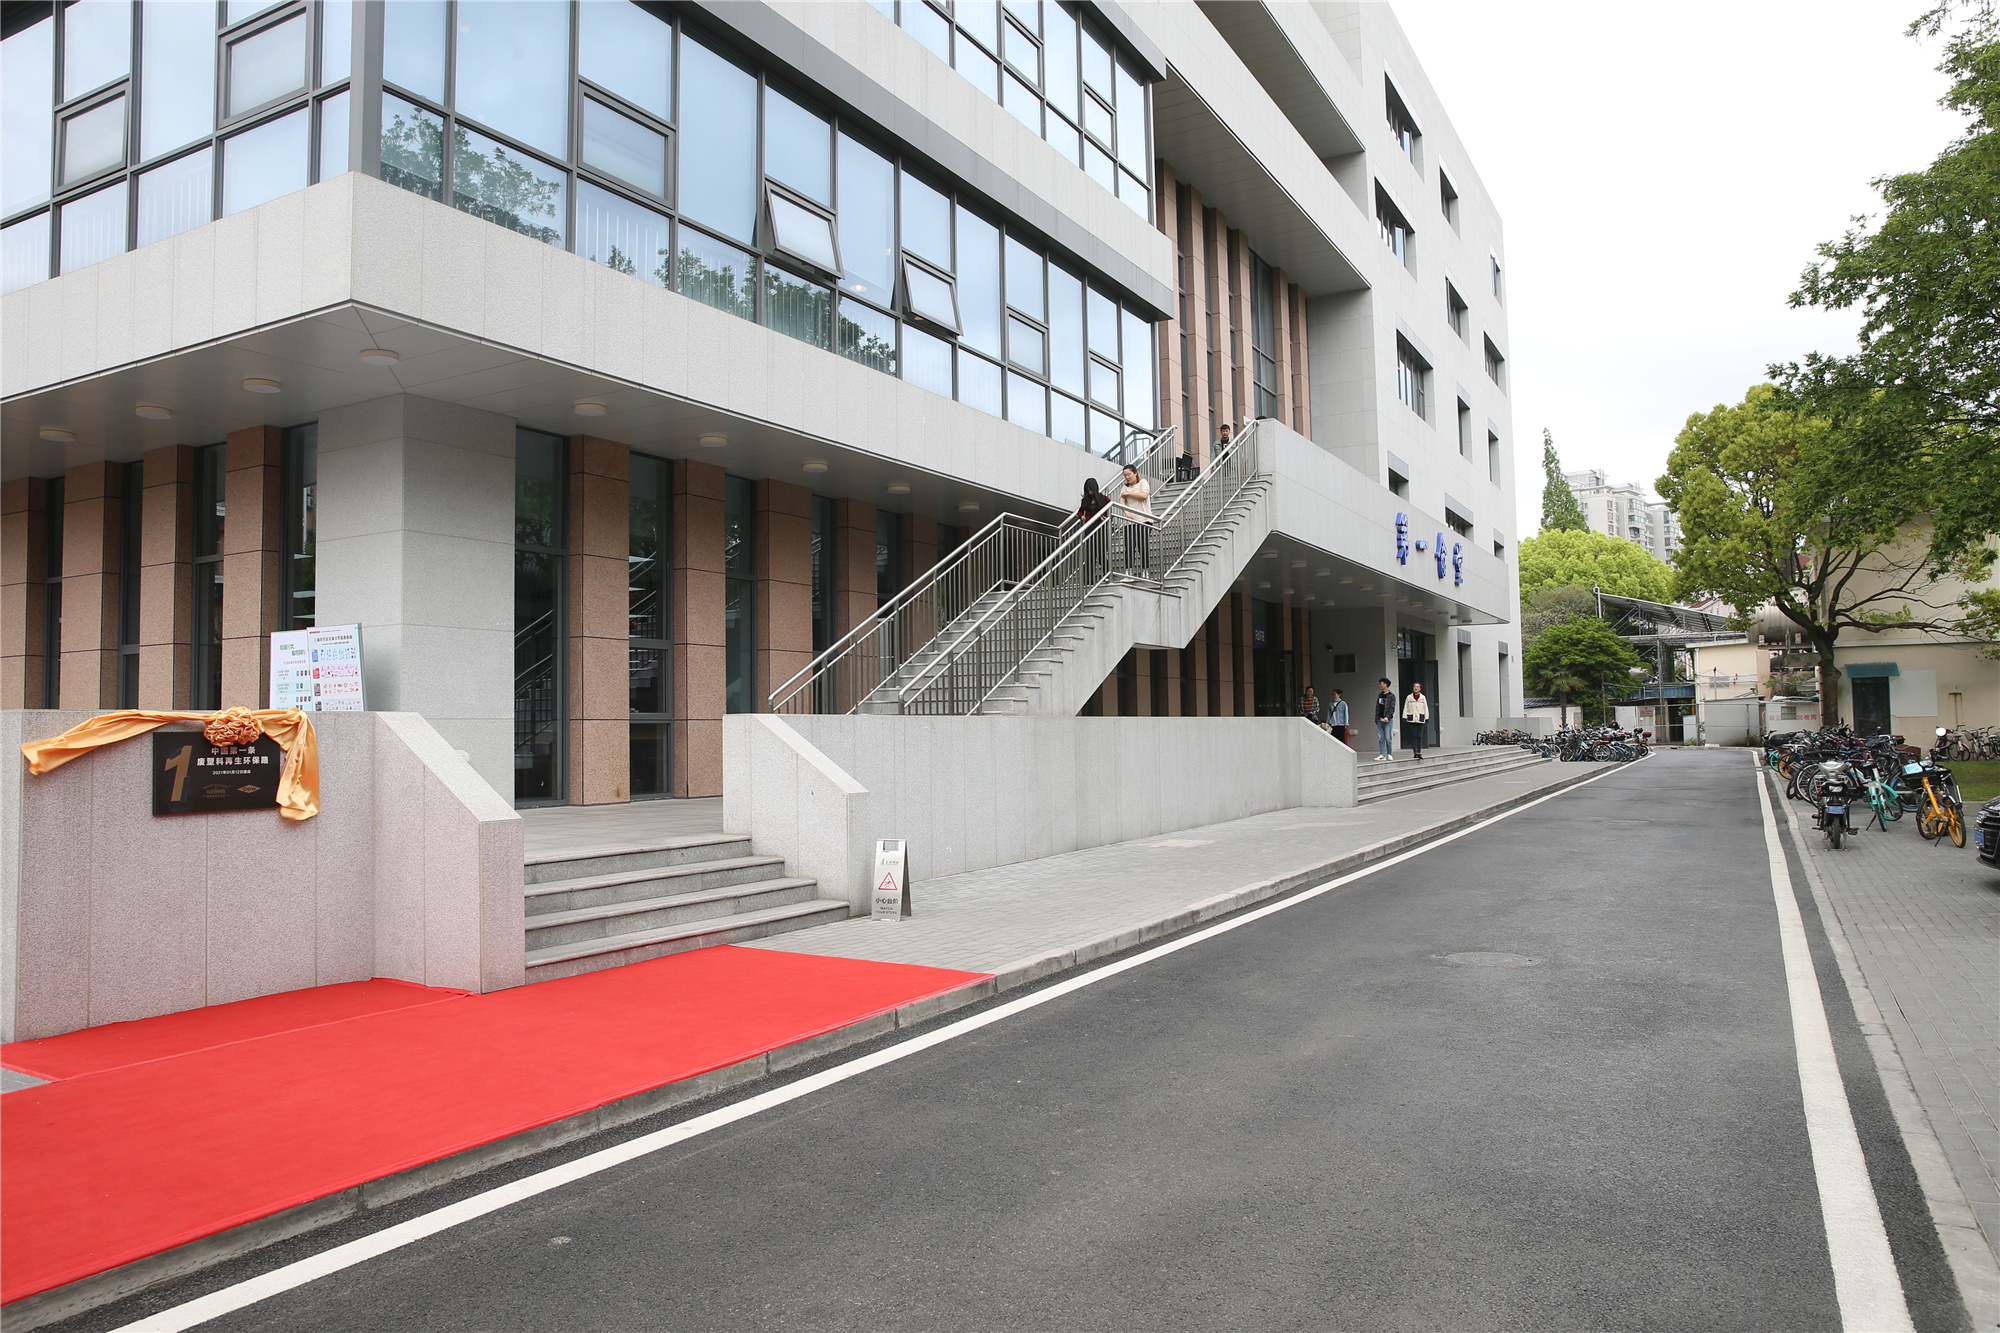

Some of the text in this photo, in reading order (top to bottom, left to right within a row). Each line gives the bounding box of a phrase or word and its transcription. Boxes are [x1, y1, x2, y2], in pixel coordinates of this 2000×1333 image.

[211, 746, 256, 756] 中国第一条
